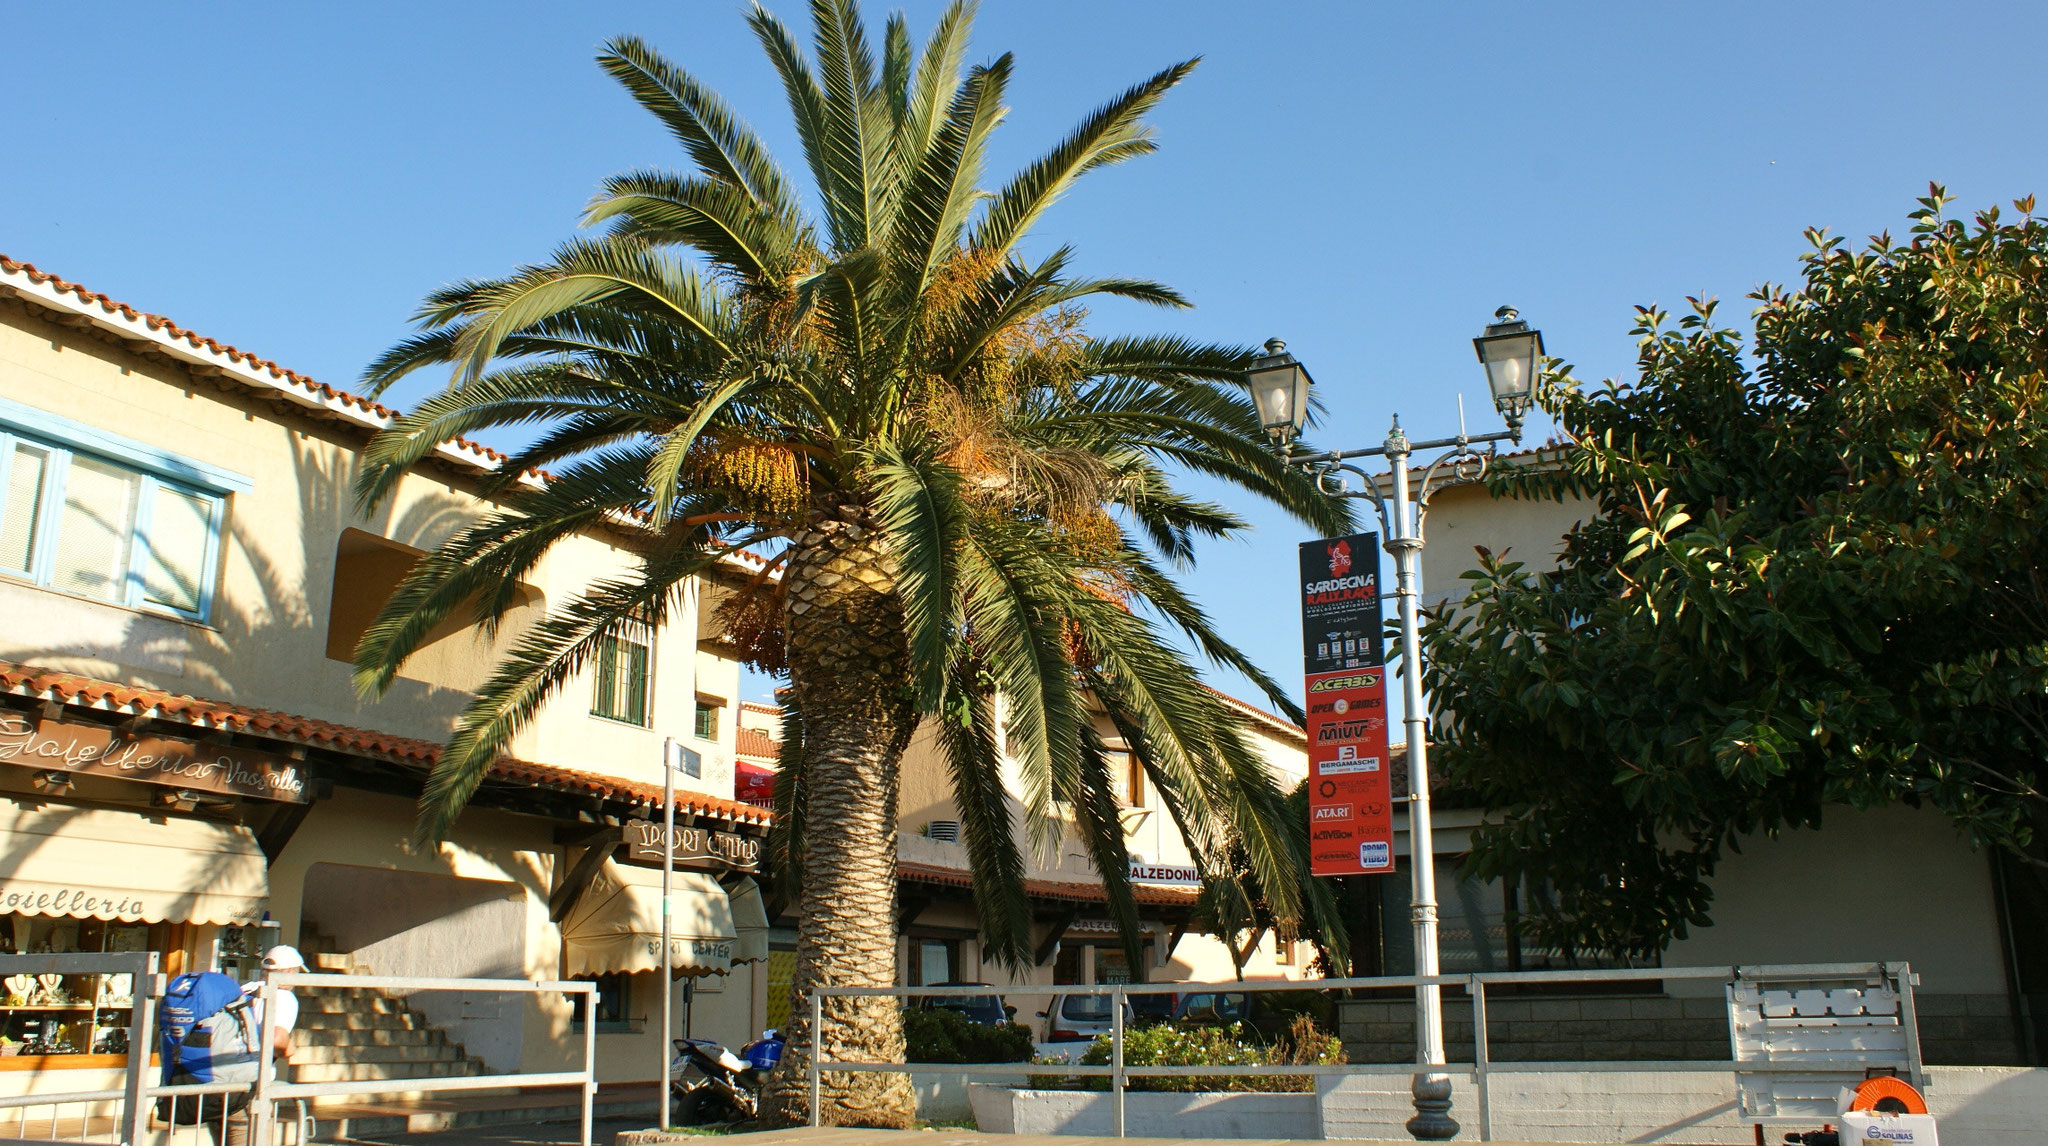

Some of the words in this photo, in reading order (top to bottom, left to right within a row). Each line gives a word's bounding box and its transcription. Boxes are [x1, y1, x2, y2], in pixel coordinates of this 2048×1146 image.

[1306, 573, 1374, 594] SARDEGNA
[1306, 590, 1345, 605] RALLY
[1344, 586, 1375, 600] RACE
[1310, 674, 1379, 692] ACERBIS
[1311, 703, 1335, 714] OPEN
[1349, 698, 1381, 710] GAMES
[1320, 759, 1376, 769] BERGAMASCHI
[1315, 808, 1348, 818] ATARI
[1313, 829, 1353, 841] ACTIVISION
[1131, 867, 1202, 881] ALZEDONIA
[648, 941, 681, 955] SPRT
[692, 942, 729, 959] CENTER
